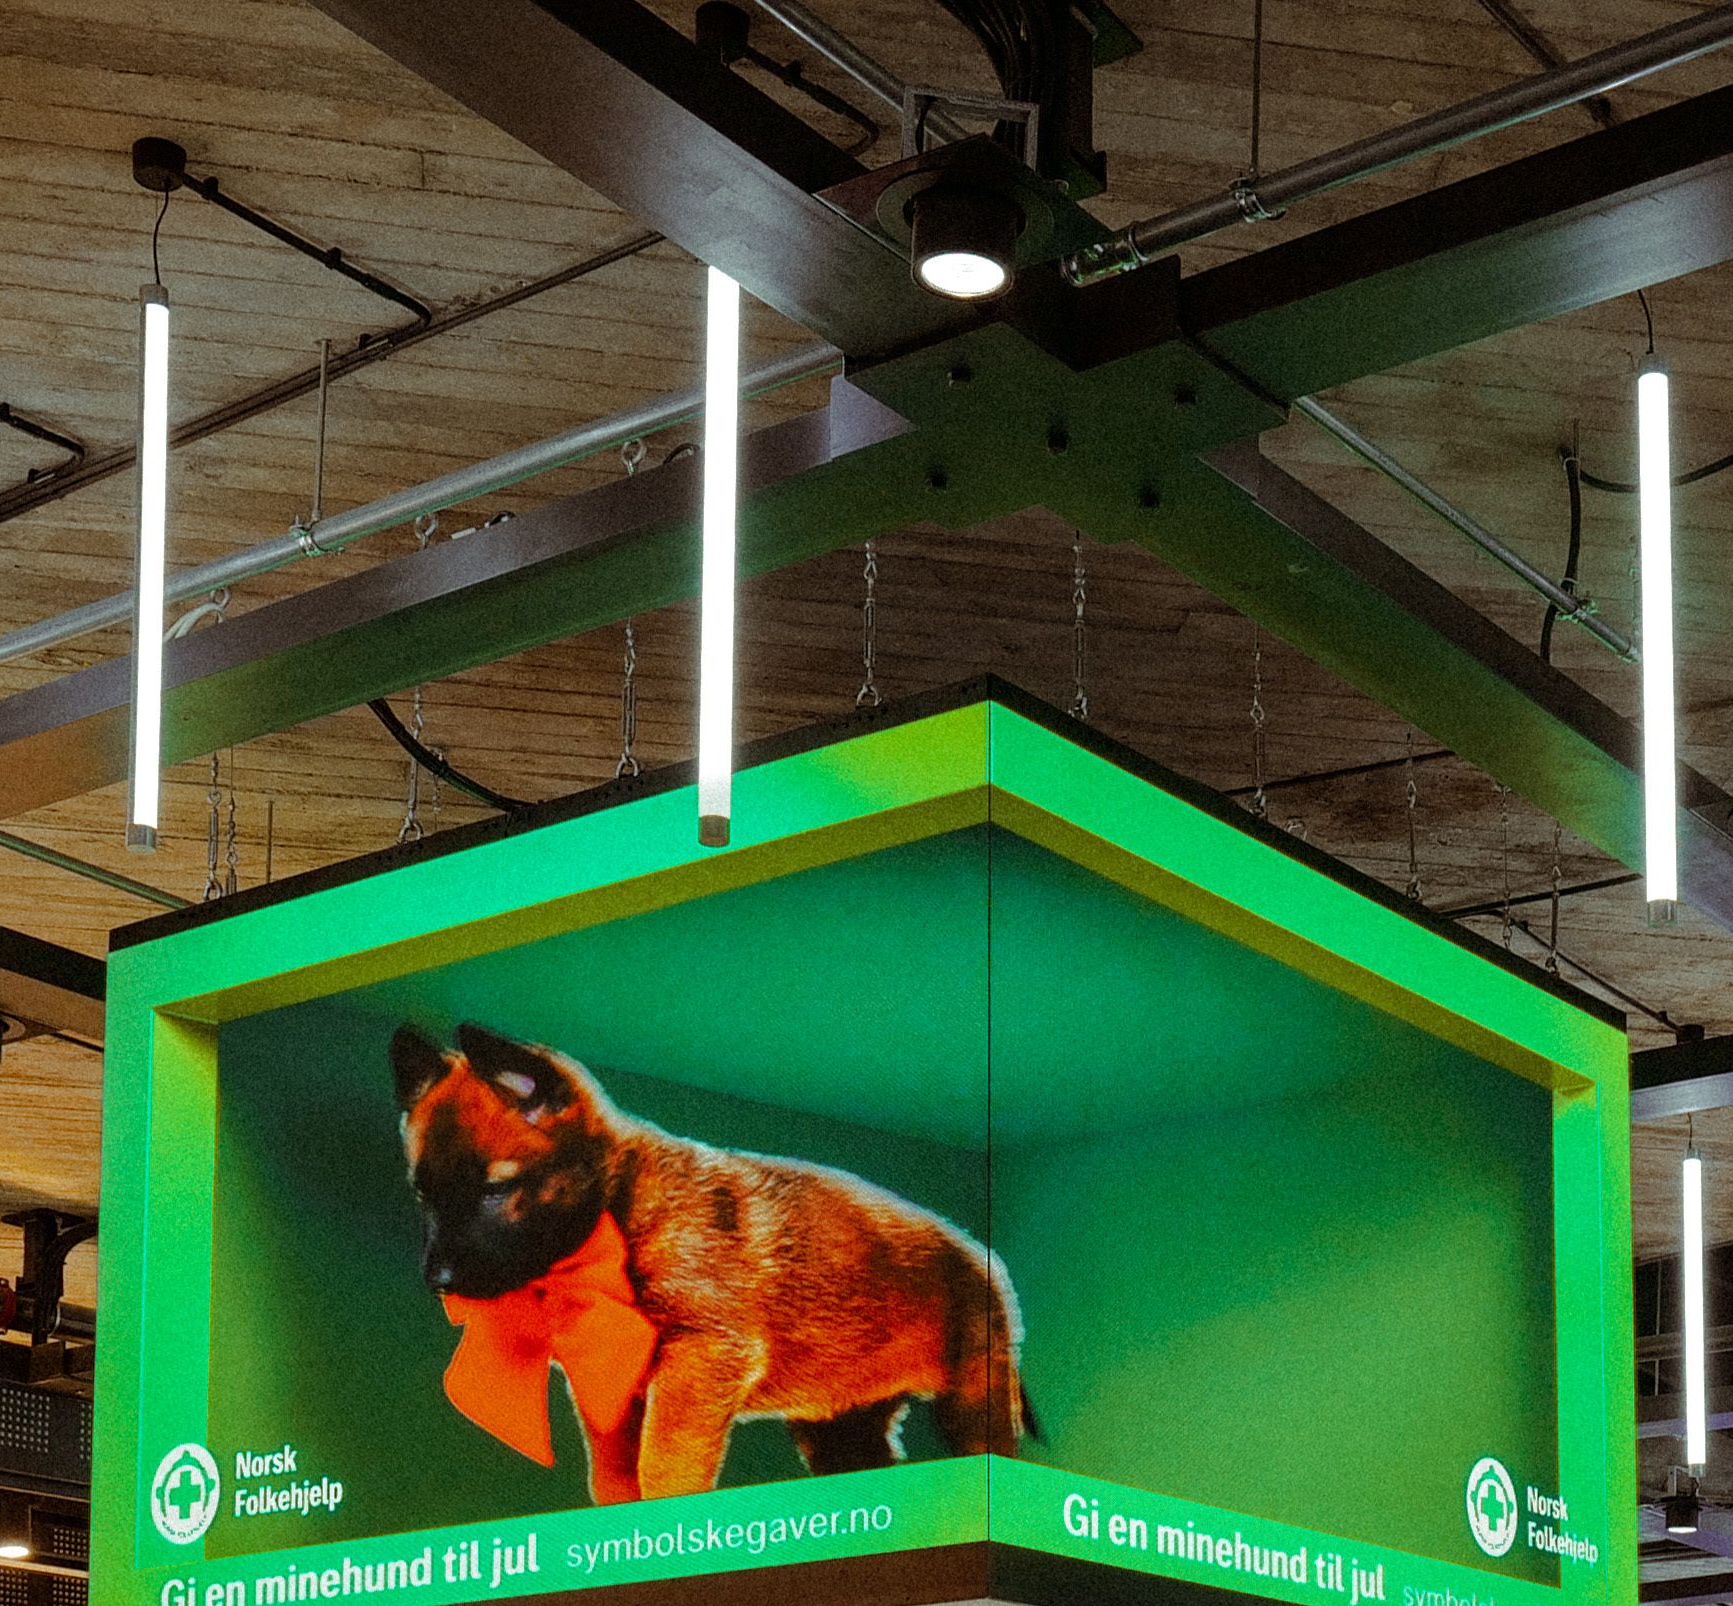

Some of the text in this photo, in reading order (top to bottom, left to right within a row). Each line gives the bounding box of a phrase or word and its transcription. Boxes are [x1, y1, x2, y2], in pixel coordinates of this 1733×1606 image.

[235, 1444, 298, 1481] Norsk
[234, 1477, 344, 1518] Folkehjelp
[1526, 1485, 1569, 1522] Norsk
[254, 1547, 433, 1606] minehund
[442, 1541, 482, 1584] til
[489, 1533, 540, 1589] jul
[566, 1504, 893, 1575] symbolskegaver.no
[1062, 1492, 1100, 1541] Gi
[1107, 1507, 1149, 1550] en
[1155, 1520, 1309, 1587] minehund
[1313, 1553, 1345, 1593] til
[1348, 1556, 1386, 1606] jul
[1527, 1520, 1599, 1568] Folkehjelp
